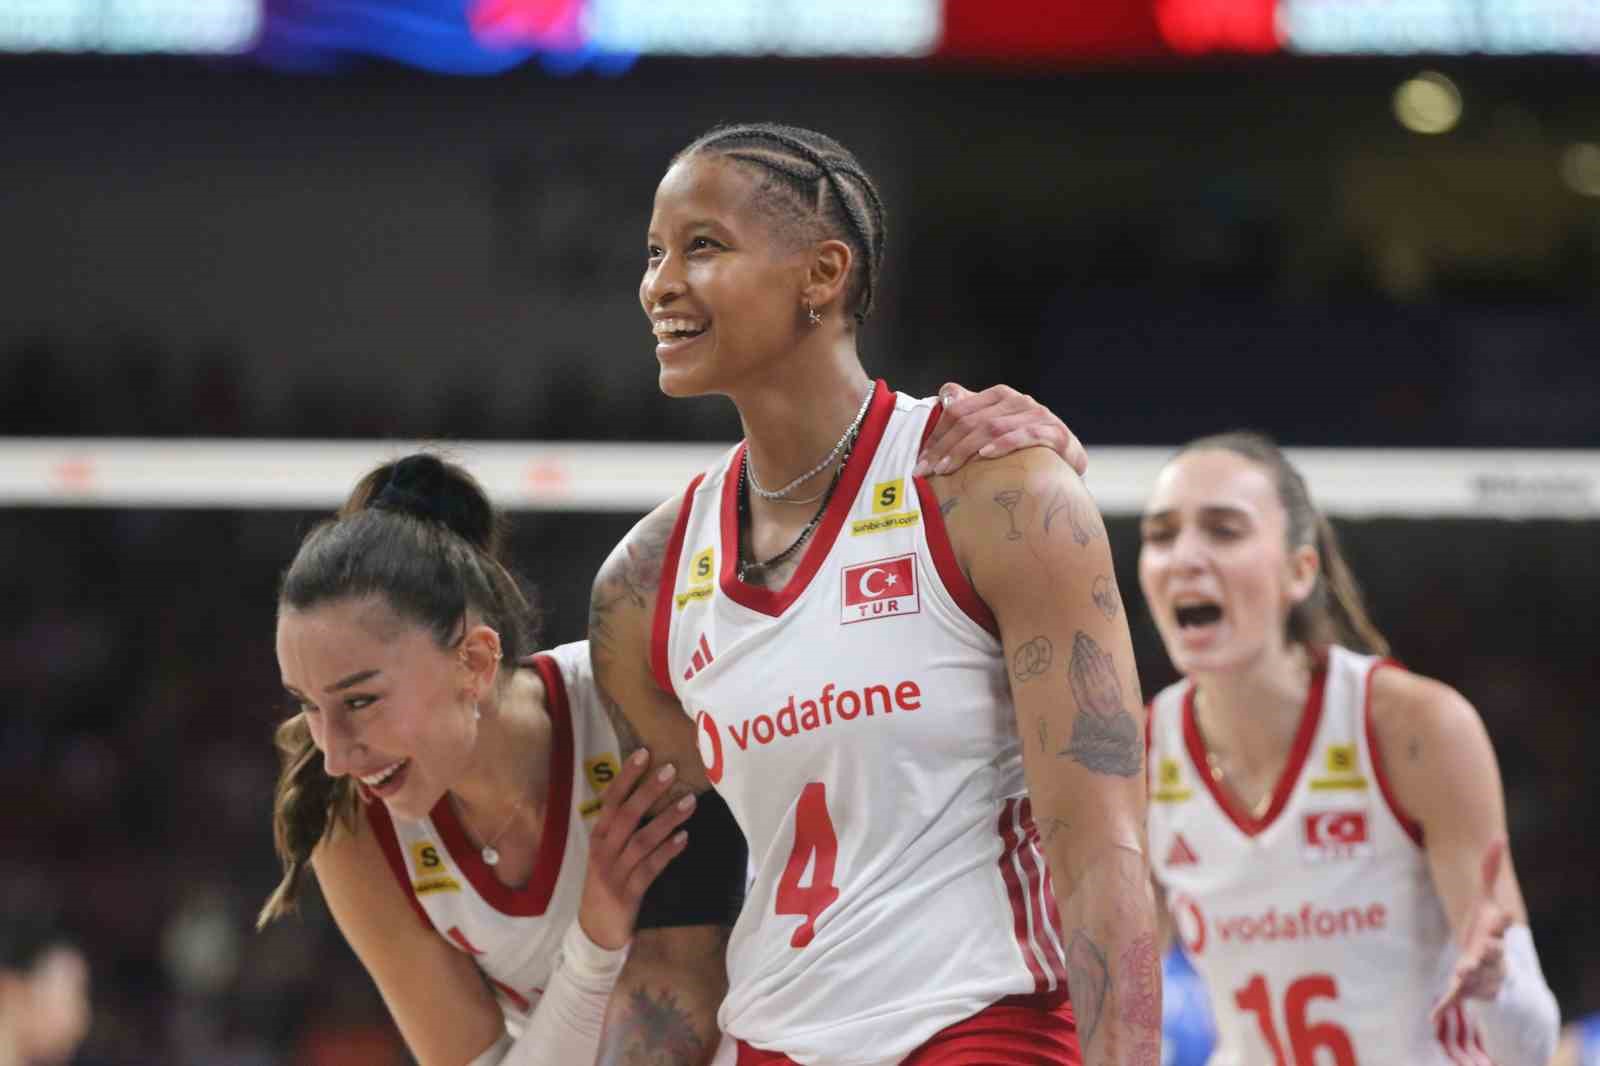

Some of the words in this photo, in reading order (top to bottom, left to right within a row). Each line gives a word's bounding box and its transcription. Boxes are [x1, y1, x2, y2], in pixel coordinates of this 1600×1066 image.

[879, 486, 897, 506] S
[697, 556, 710, 577] S
[858, 599, 899, 616] TUR
[728, 680, 921, 750] vodafone
[592, 762, 614, 782] S
[421, 847, 439, 867] S
[775, 782, 840, 948] 4
[1214, 903, 1388, 944] vodafone
[1234, 973, 1358, 1066] 16
